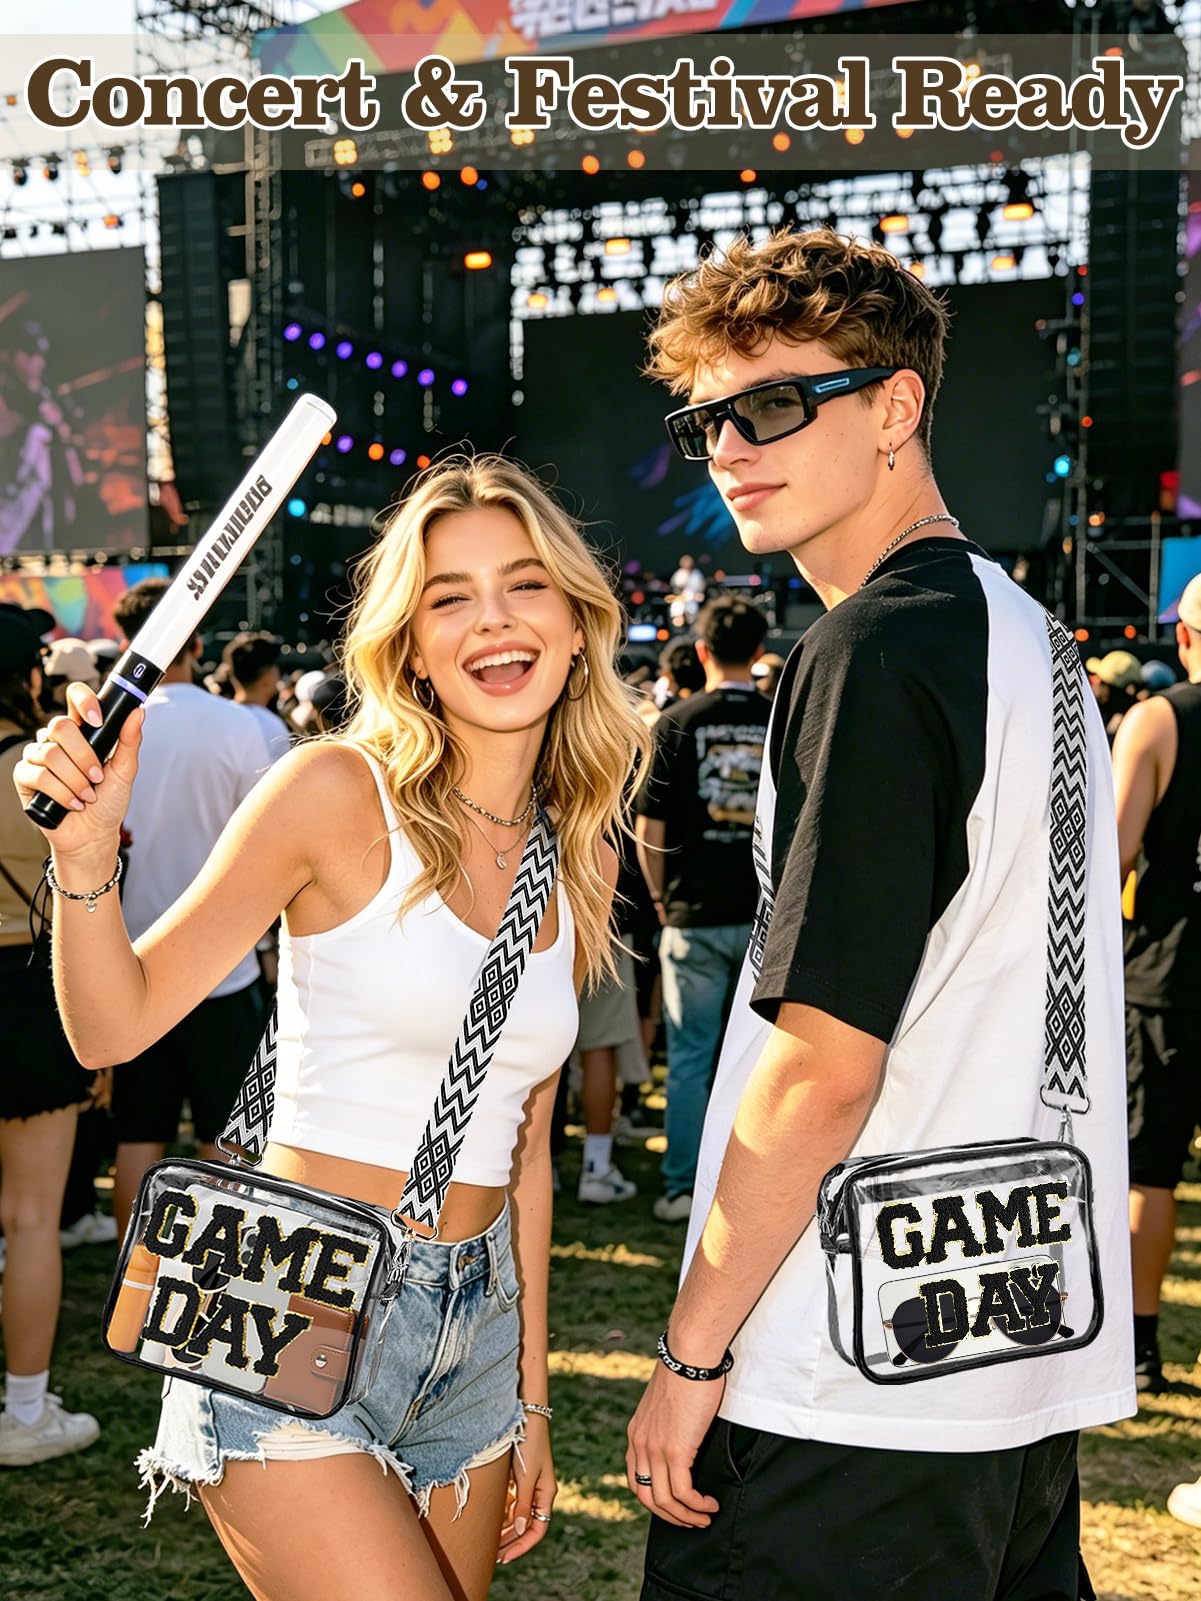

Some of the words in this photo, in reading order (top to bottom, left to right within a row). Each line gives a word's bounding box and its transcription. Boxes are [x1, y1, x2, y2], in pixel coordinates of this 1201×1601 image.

[143, 1187, 373, 1311] GAME
[876, 1181, 1072, 1269] GAME
[141, 1275, 314, 1379] DAY
[919, 1261, 1059, 1348] DAY
